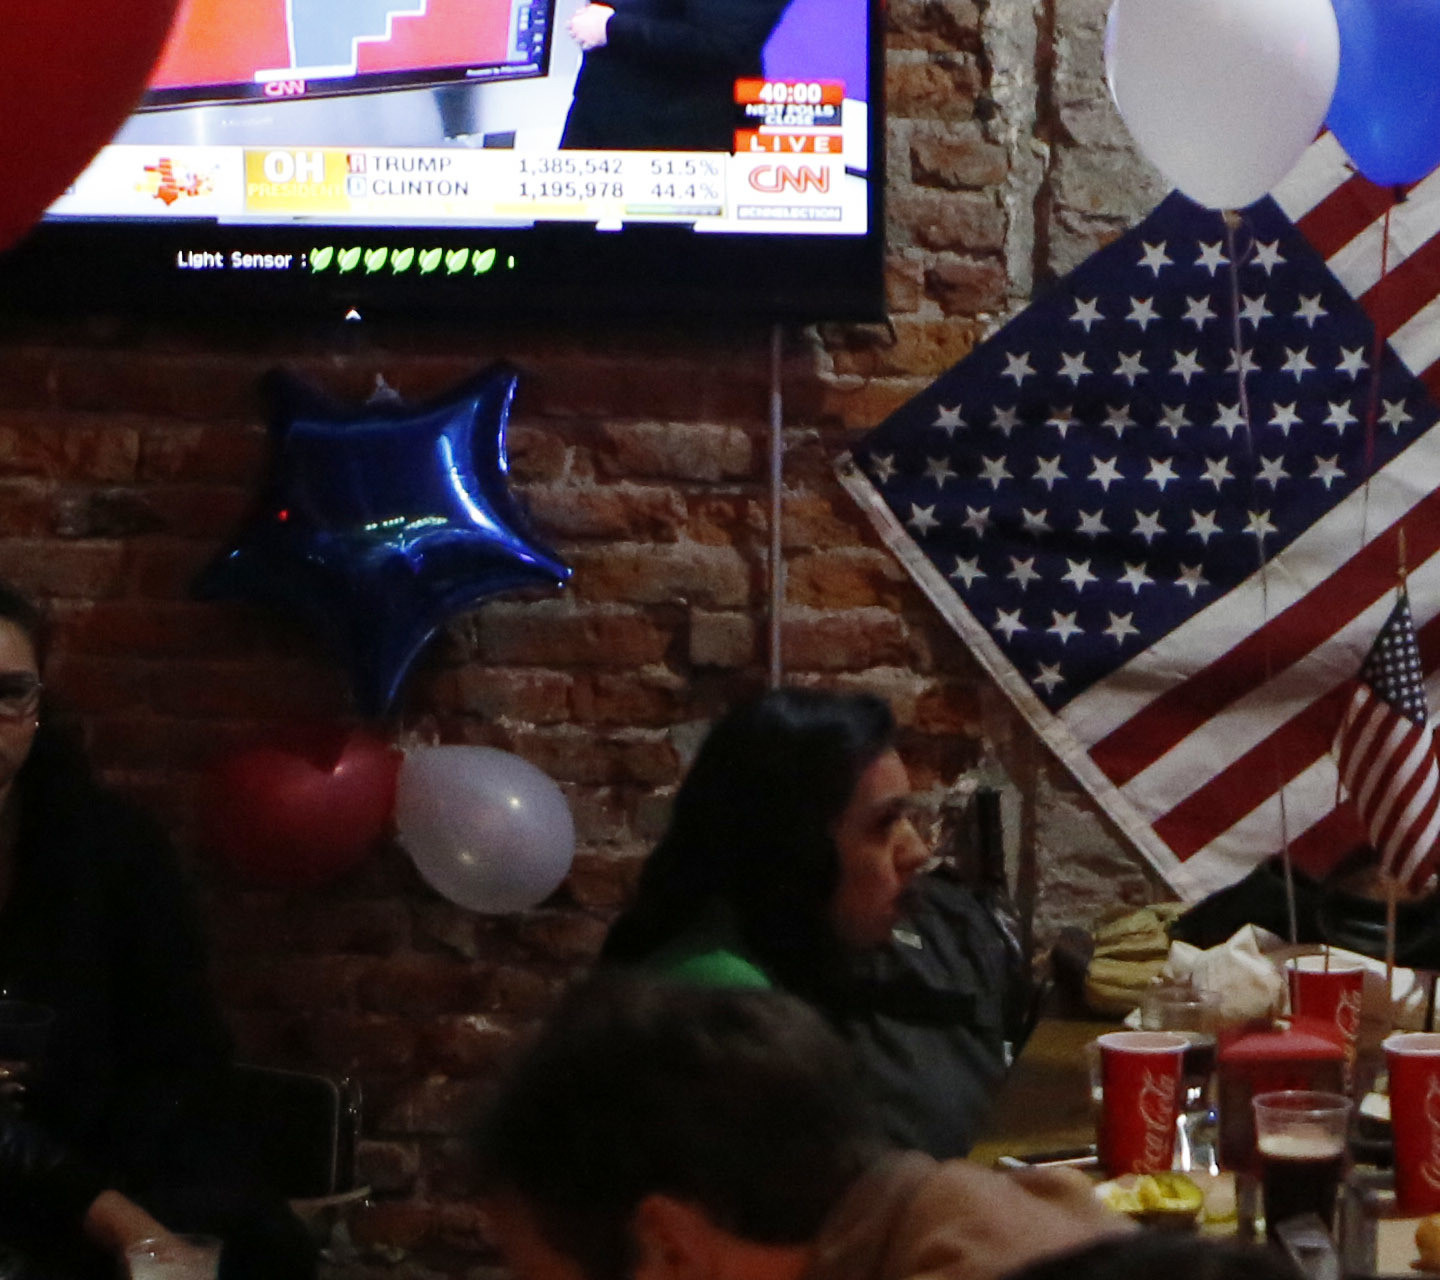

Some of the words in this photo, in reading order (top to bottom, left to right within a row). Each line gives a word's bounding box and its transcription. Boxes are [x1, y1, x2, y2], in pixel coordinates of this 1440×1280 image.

[265, 80, 305, 97] CNN
[759, 83, 822, 103] 40:00
[746, 104, 785, 116] NEXT
[750, 134, 830, 153] LIVE
[264, 151, 325, 183] OH
[372, 155, 452, 173] TRUMP
[519, 158, 623, 176] 1,385,542
[651, 159, 719, 176] 51.5%
[372, 178, 469, 197] CLINTON
[519, 181, 624, 200] 1,195,978
[651, 182, 719, 200] 44.4%
[748, 164, 830, 194] CNN
[177, 251, 224, 269] Light
[231, 251, 293, 269] Sensor
